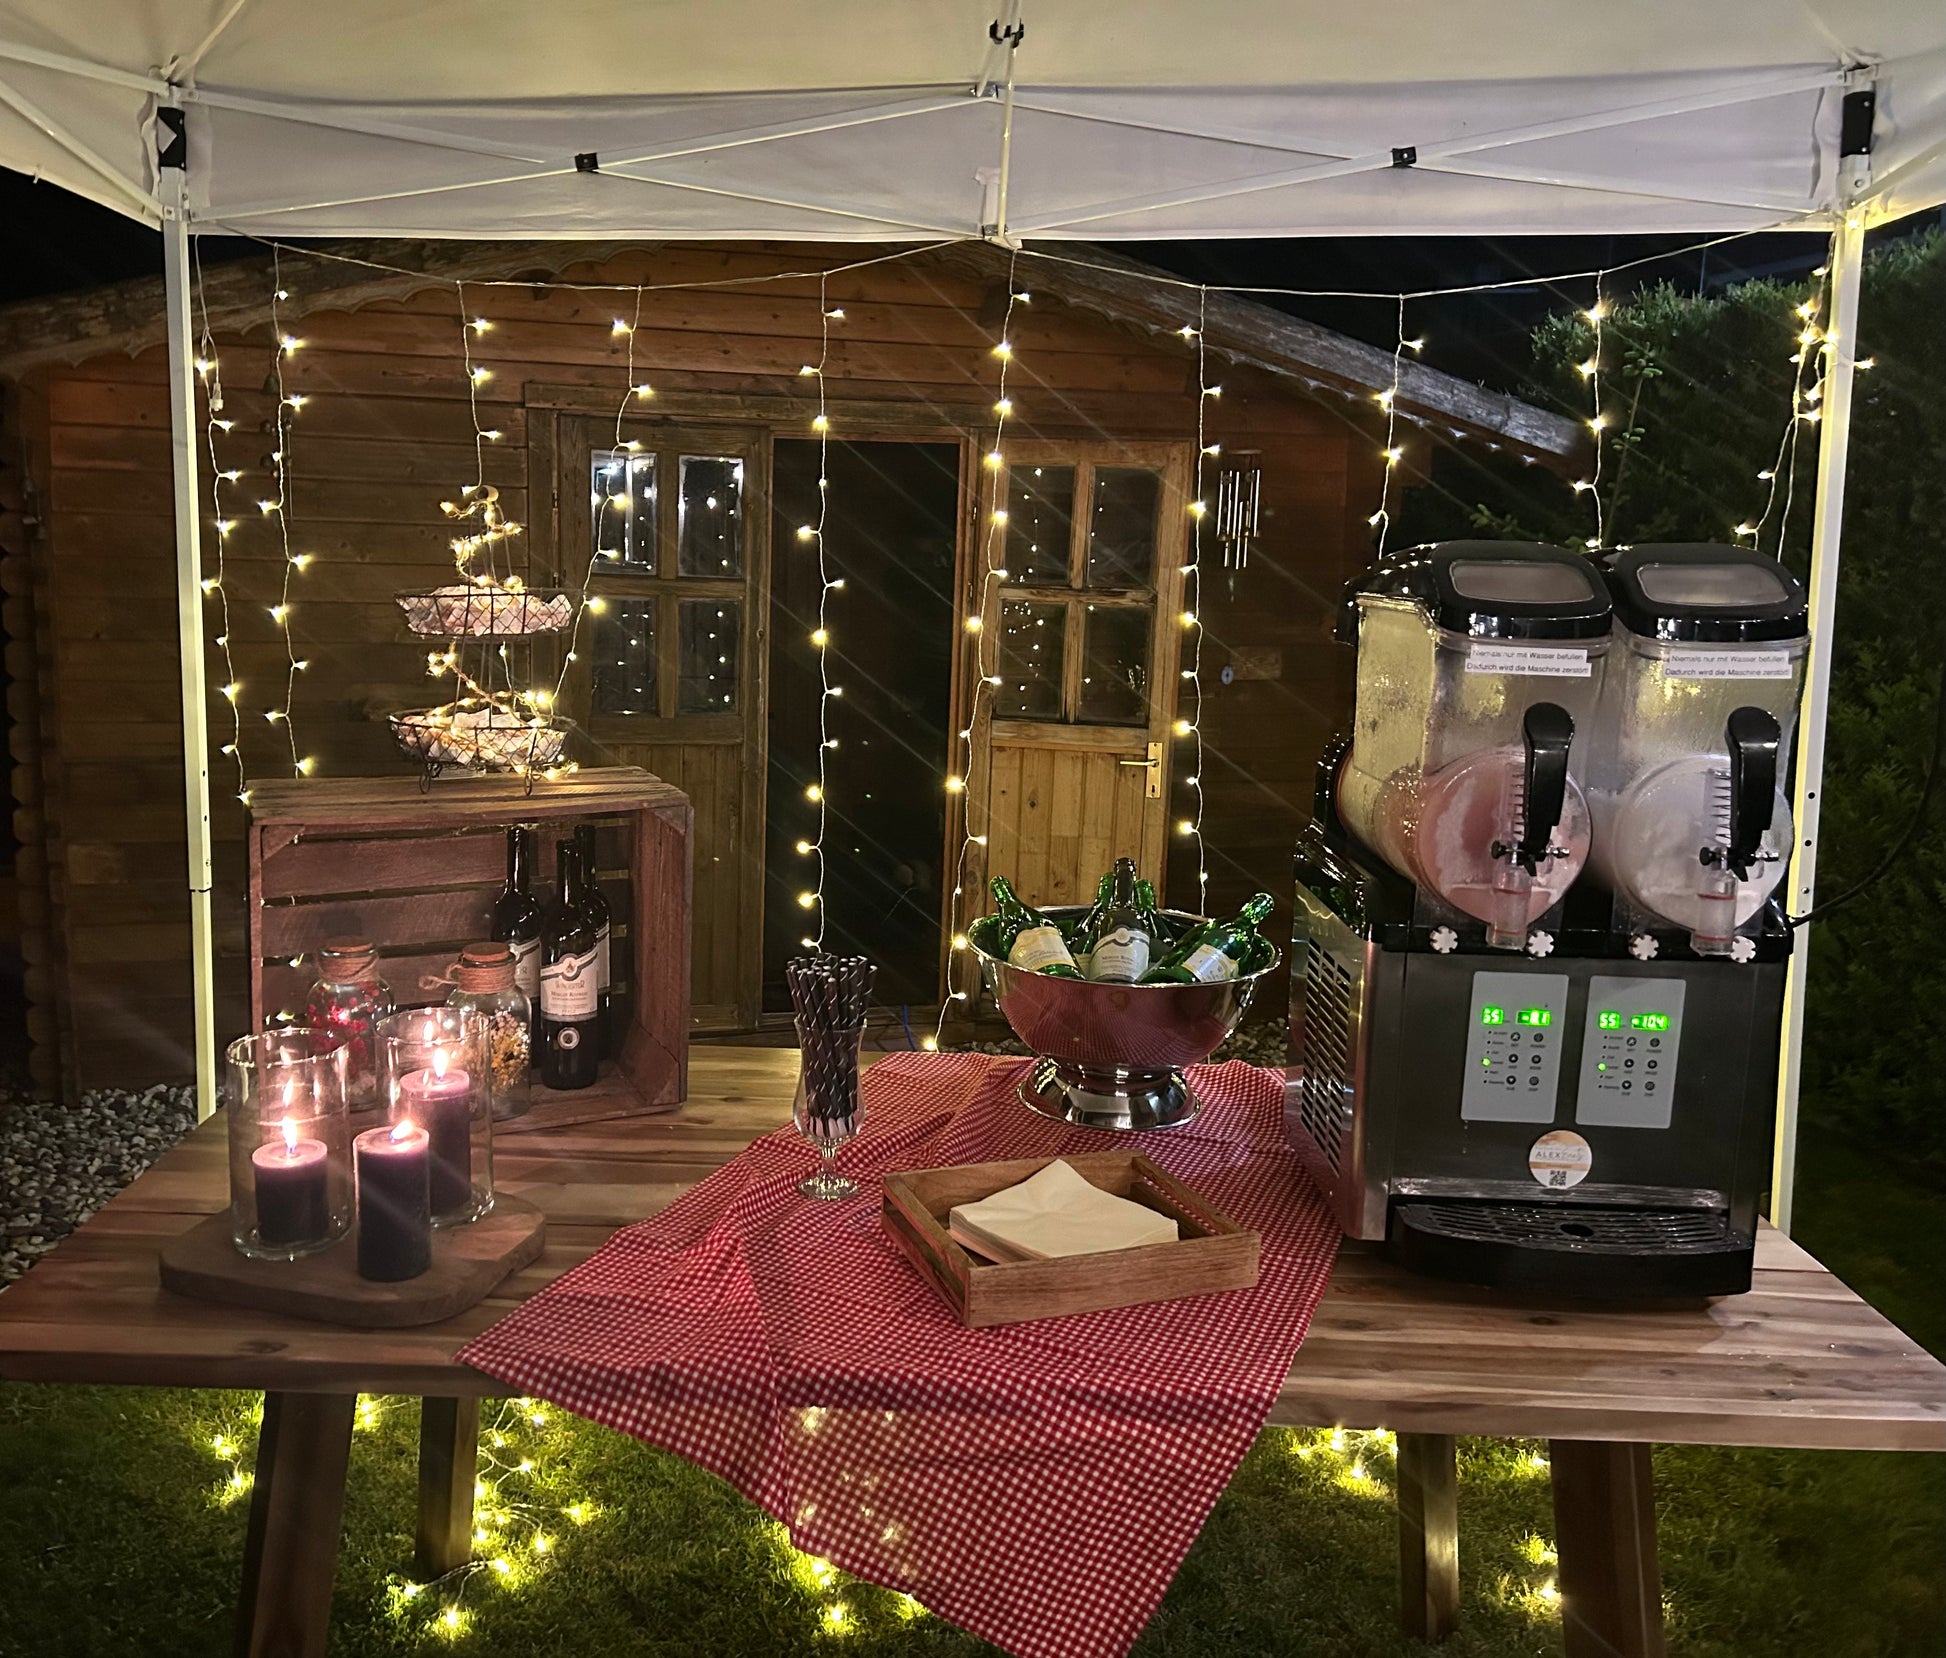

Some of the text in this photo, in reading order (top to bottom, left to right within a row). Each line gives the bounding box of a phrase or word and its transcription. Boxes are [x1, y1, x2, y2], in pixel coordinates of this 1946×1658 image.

[1529, 652, 1555, 660] Wasser
[1498, 663, 1514, 672] wird
[1515, 664, 1526, 672] die
[1527, 664, 1560, 673] Maschine
[1698, 667, 1713, 676] wird
[1727, 667, 1760, 676] Maschine
